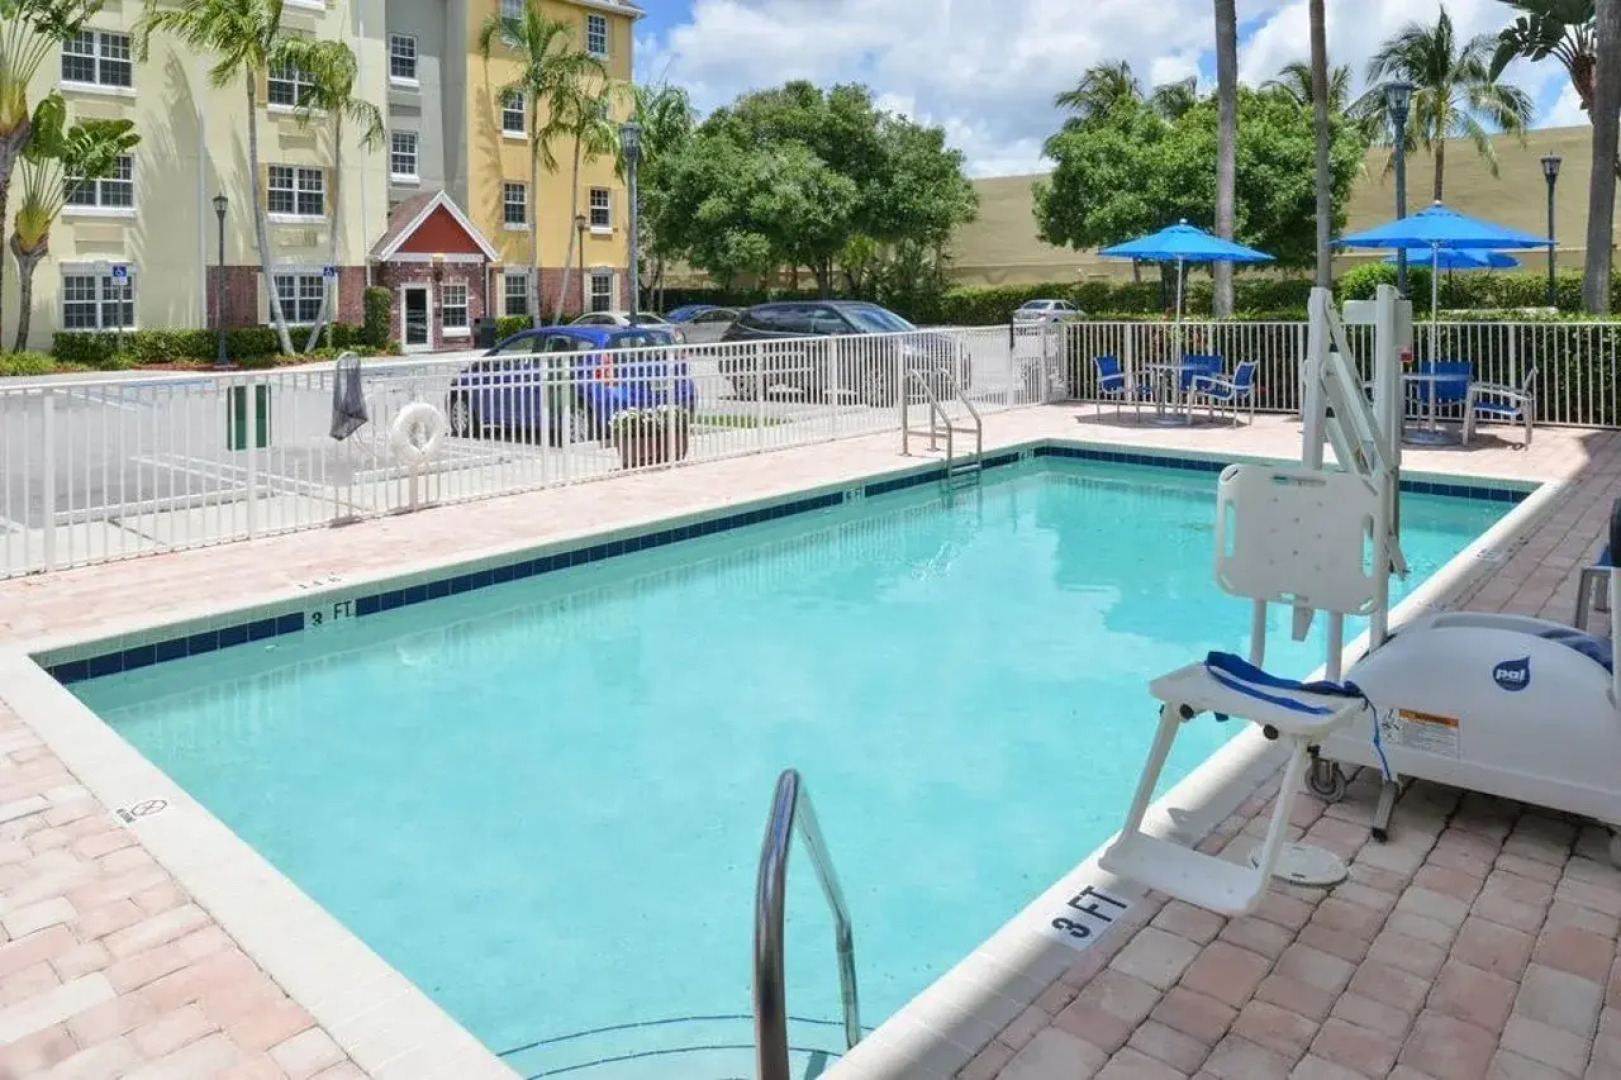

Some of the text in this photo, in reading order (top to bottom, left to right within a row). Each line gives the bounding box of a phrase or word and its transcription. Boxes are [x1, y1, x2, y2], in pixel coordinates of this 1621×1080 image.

[312, 600, 353, 626] 3 FT
[1496, 668, 1526, 683] pal
[1051, 884, 1128, 938] 3 FT
